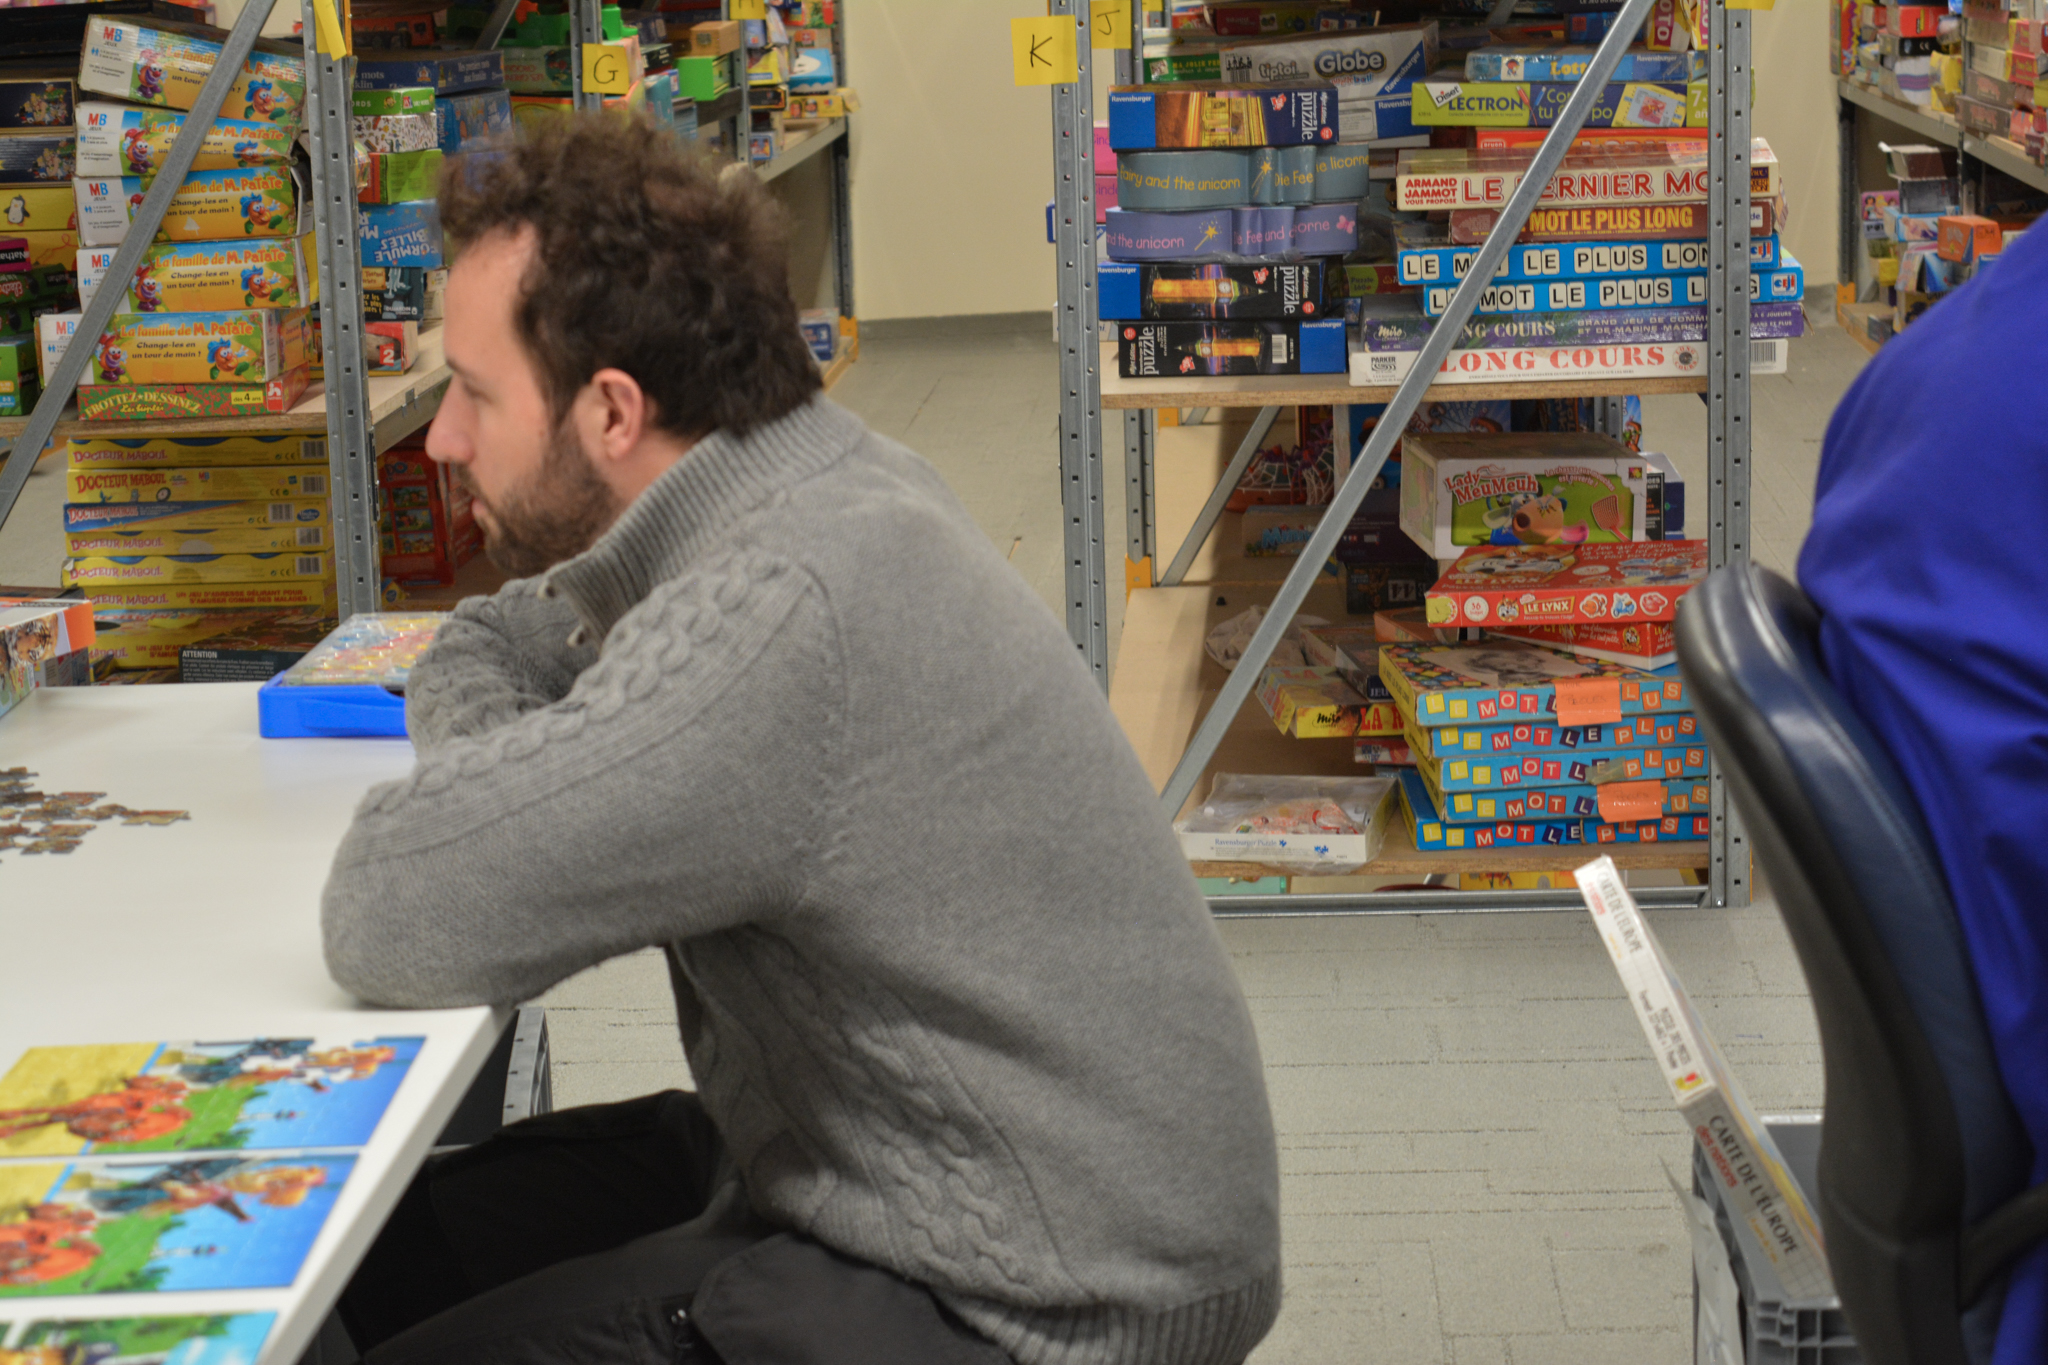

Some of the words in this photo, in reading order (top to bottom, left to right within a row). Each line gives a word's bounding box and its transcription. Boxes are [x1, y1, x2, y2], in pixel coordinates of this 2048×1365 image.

[1096, 9, 1120, 36] J
[103, 26, 123, 42] MB
[1030, 34, 1053, 68] K
[1637, 55, 1677, 63] Ravensburger
[593, 54, 618, 84] G
[1259, 61, 1297, 78] tiptoi
[1319, 52, 1383, 72] Globe
[361, 71, 385, 80] mots
[1385, 50, 1422, 93] Ravensburger
[1111, 95, 1152, 103] Ravensburger
[1435, 85, 1460, 106] Diset
[1379, 100, 1412, 109] Ravensbu
[1448, 97, 1523, 111] LECTRON
[1538, 105, 1553, 119] tu
[88, 113, 107, 126] MB
[1297, 92, 1314, 140] puzzle
[151, 122, 166, 133] La
[1120, 164, 1144, 188] fairy
[1146, 172, 1170, 190] and
[1174, 175, 1195, 191] the
[1198, 177, 1241, 191] unicorn
[1274, 172, 1291, 187] Die
[1293, 171, 1315, 184] Fee
[1405, 178, 1457, 188] ARMAND
[89, 183, 108, 196] MB
[209, 179, 222, 193] de
[1405, 188, 1457, 199] JAMMOT
[1464, 178, 1502, 202] LE
[179, 208, 198, 216] tour
[1530, 210, 1569, 232] MOT
[1571, 209, 1592, 231] LE
[1596, 207, 1641, 230] PLUS
[1644, 206, 1693, 229] LONG
[381, 228, 430, 250] BILLES
[1117, 232, 1133, 248] the
[1136, 236, 1185, 249] unicorn
[1246, 231, 1262, 245] Fee
[1265, 226, 1285, 242] und
[91, 254, 111, 268] MB
[155, 255, 170, 268] La
[171, 253, 209, 268] famille
[211, 252, 225, 265] de
[1406, 258, 1437, 276] LE
[1526, 253, 1558, 271] LE
[1577, 249, 1645, 268] PLUS
[171, 271, 217, 280] Change-les
[1097, 267, 1137, 275] Ravensburger
[178, 281, 196, 289] tour
[209, 279, 230, 287] main
[1279, 265, 1296, 314] puzzle
[1480, 289, 1532, 307] MOT
[1552, 286, 1583, 304] LE
[1602, 281, 1671, 301] PLUS
[56, 321, 75, 335] MB
[1302, 322, 1342, 330] Ravensburger
[1493, 320, 1556, 338] COURS
[1577, 318, 1617, 327] GRAND
[1622, 316, 1644, 325] JEU
[1649, 316, 1665, 324] DE
[1577, 327, 1591, 335] ET
[1596, 326, 1610, 335] DE
[1614, 324, 1659, 334] MARINE
[121, 325, 135, 337] La
[136, 323, 176, 337] famille
[177, 323, 192, 336] de
[136, 341, 184, 349] Change-les
[1142, 326, 1159, 376] puzzle
[383, 349, 395, 364] 2
[1549, 345, 1666, 370] COURS
[84, 392, 138, 418] FROTTEZ
[143, 391, 201, 413] DESSINEZ
[244, 392, 250, 402] 4
[76, 474, 129, 494] DOCTEUR
[130, 473, 167, 486] MABOUL
[1446, 471, 1480, 493] Lady
[1455, 477, 1539, 506] MeuMeuh
[1471, 602, 1482, 611] 36
[1528, 602, 1540, 612] LE
[1541, 600, 1569, 612] LYNX
[182, 650, 218, 659] ATTENTION
[1428, 696, 1466, 717] LE
[1479, 694, 1536, 717] MOT
[1360, 707, 1384, 730] LA
[1445, 729, 1479, 747] LE
[1493, 727, 1549, 748] MOT
[1564, 728, 1599, 745] LE
[1617, 718, 1694, 742] PLUS
[1455, 761, 1489, 782] LE
[1502, 761, 1560, 783] MOT
[1626, 750, 1702, 775] PLUS
[1459, 795, 1494, 815] LE
[1507, 796, 1563, 817] MOT
[1427, 826, 1462, 845] LE
[1476, 824, 1532, 846] MOT
[1546, 826, 1581, 844] LE
[1601, 819, 1677, 841] PLUS
[1214, 838, 1256, 848] Ravensburger
[1257, 838, 1277, 847] Puzzle
[1695, 1124, 1714, 1148] des
[1711, 1146, 1739, 1188] nations
[1709, 1114, 1744, 1163] CARTE
[1736, 1163, 1758, 1187] DE
[1750, 1183, 1799, 1255] L'EUROPE
